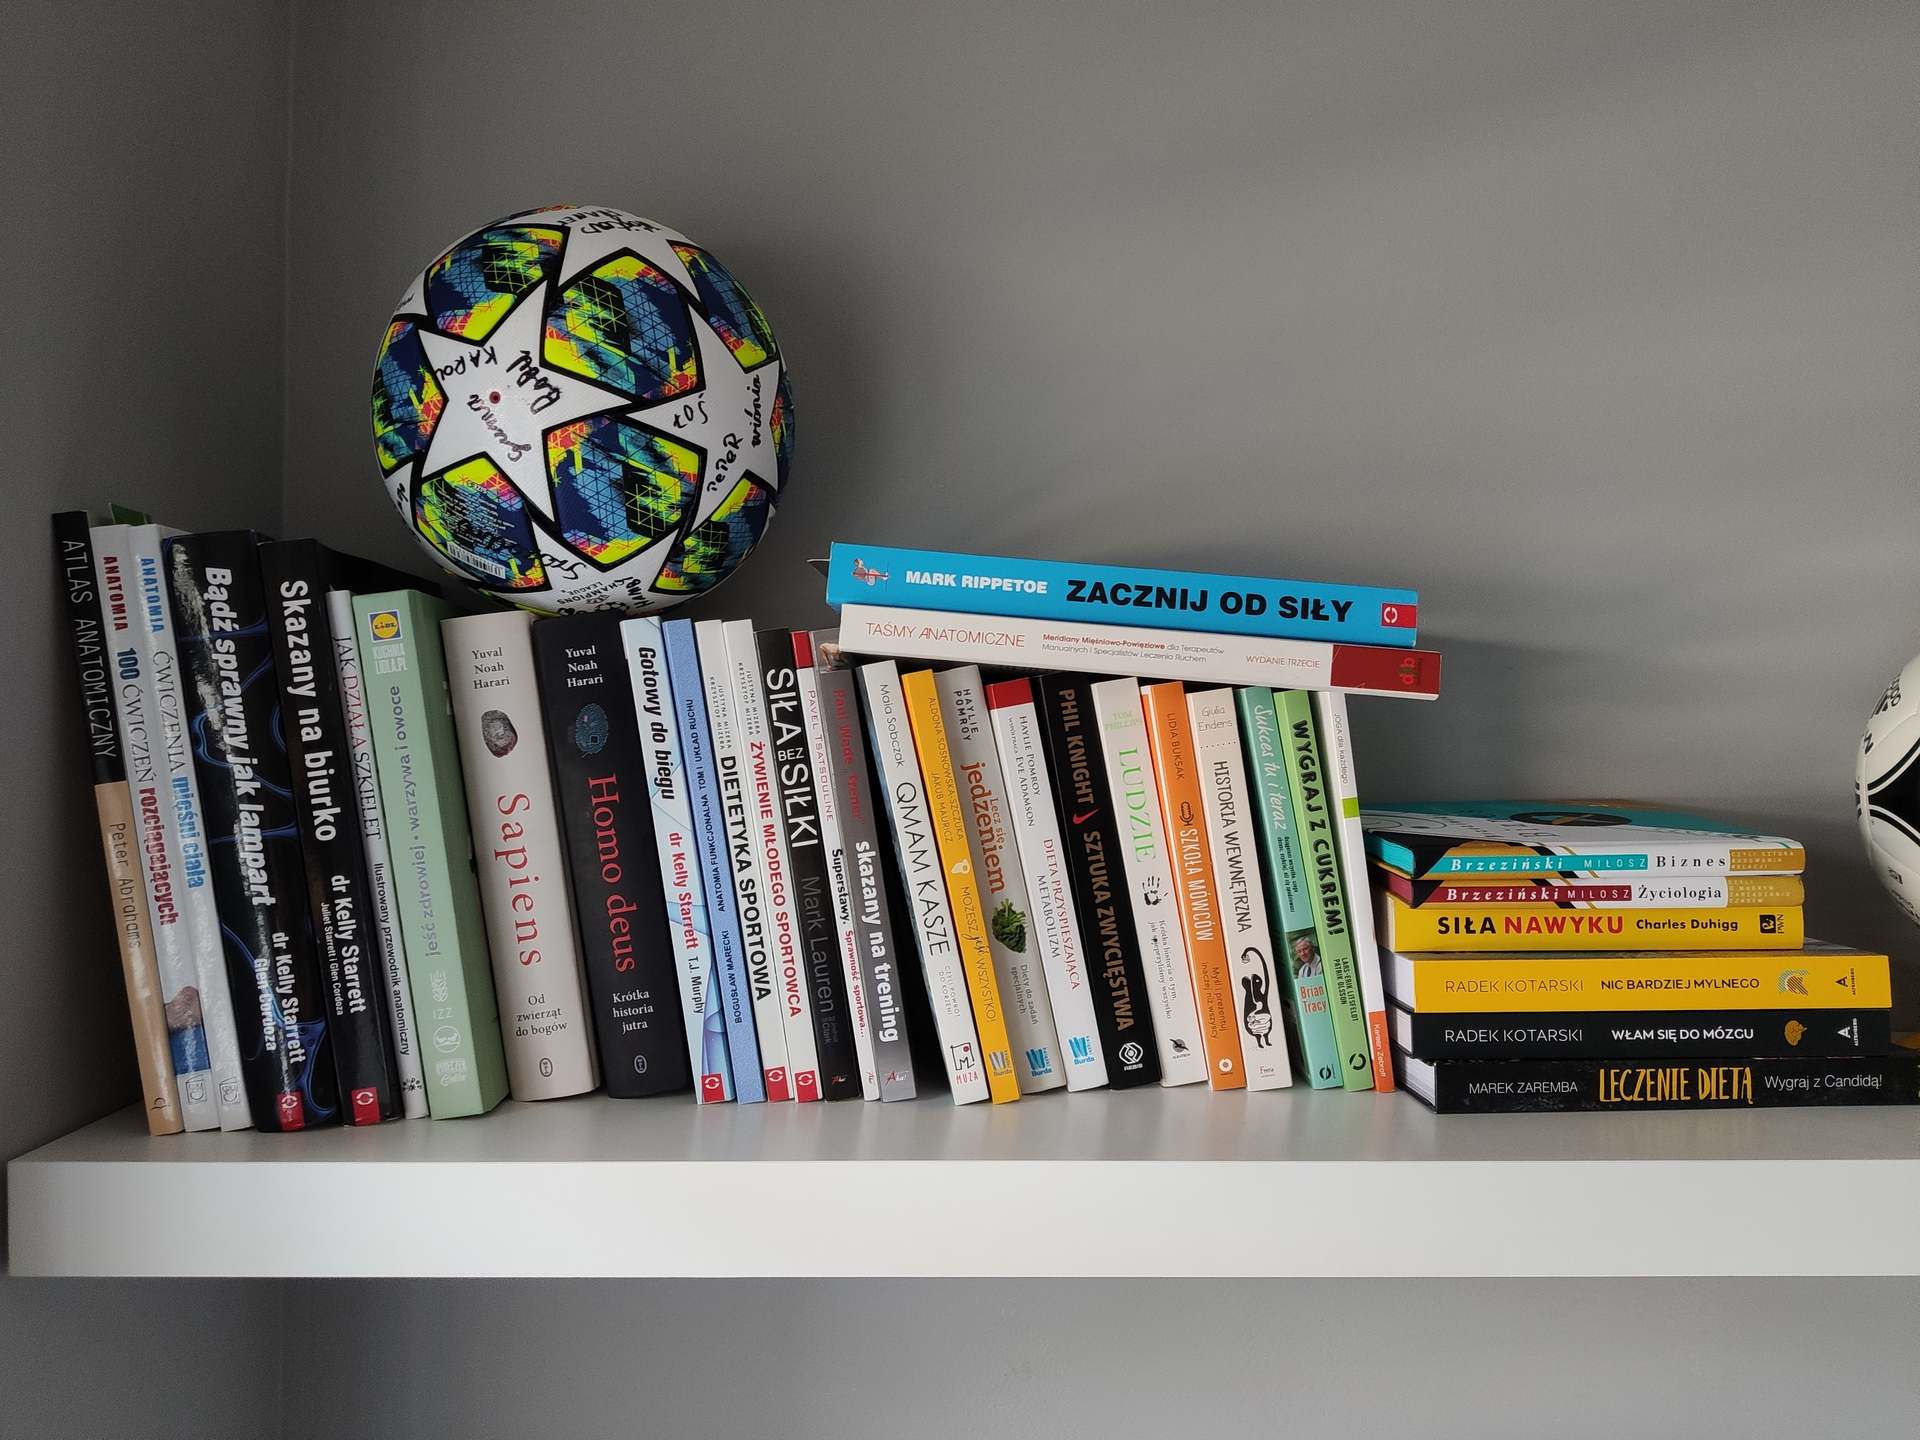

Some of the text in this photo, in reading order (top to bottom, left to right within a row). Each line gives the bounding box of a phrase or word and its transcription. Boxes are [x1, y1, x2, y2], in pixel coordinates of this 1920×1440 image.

[905, 571, 1353, 623] MARK RIPPETOE ZACZNIJ OD SIŁY
[63, 540, 117, 759] ATLAS ANATOMICZNY
[472, 647, 503, 660] Yuval
[565, 645, 596, 658] Yuval
[865, 621, 1025, 648] TAŚMY ANATOMICZNE
[1042, 643, 1138, 658] Manualnych Specjalistów
[1043, 634, 1079, 644] Meridiany
[473, 676, 510, 690] Harari
[474, 662, 505, 675] Noah
[566, 674, 603, 688] Harari
[567, 660, 598, 673] Noah
[1246, 655, 1321, 669] WYDANIE TRZECIE
[140, 558, 200, 840] ANATOMIA ĆWICZENIA mięśni
[280, 580, 341, 842] Skazany na biurko
[390, 686, 406, 740] owoce
[639, 647, 674, 800] Gotowy do biegu
[880, 683, 905, 768] Maja Sobczak
[928, 697, 941, 735] ALDONA
[954, 690, 971, 742] POMROY
[962, 688, 979, 734] HAYLIE
[1334, 713, 1344, 736] JOGA
[103, 556, 179, 926] ANATOMIA 100 ĆWICZEŃ rozciągających
[203, 567, 276, 906] Bądź sprawny jak lampart
[335, 637, 382, 840] JAK DZIAŁA SZKIELET
[767, 668, 819, 848] SIŁA BEZ SIŁKI
[1059, 688, 1095, 805] PHIL KNIGHT
[1167, 712, 1184, 780] LIDIA BUKSAK
[1254, 704, 1274, 758] Sukces
[400, 753, 420, 832] warzywa
[1264, 761, 1280, 777] tu
[930, 771, 952, 842] JAKUB MAURICZ
[960, 760, 1006, 895] jedzeniem
[1017, 775, 1034, 827] ADAMSON
[1119, 747, 1156, 863] LUDZIE
[1269, 790, 1288, 830] teraz
[1214, 760, 1252, 934] HISTORIA WEWNĘTRZNA
[1291, 720, 1345, 937] WYGRAJ Z CUKREM!
[109, 823, 141, 950] Peter Abrahams
[409, 845, 434, 918] zdrowiej
[494, 793, 542, 967] Sapiens
[588, 773, 638, 973] Homo deus
[686, 699, 742, 1024] BOGUSŁAW MARECKI ANATOMIA FUNKCJONALNA UKŁAD RUCHU
[720, 755, 771, 1001] DIETETYKA SPORTOWA
[750, 742, 801, 1017] ŻYWIENIE MŁODEGO SPORTOWCA
[855, 840, 880, 926] skazany
[896, 782, 931, 873] QMAM
[916, 879, 951, 956] KASZE
[1083, 831, 1110, 904] SZTUKA
[1180, 829, 1215, 942] SZKOŁA MÓWCÓW
[1451, 859, 1563, 872] Brzeziński
[1656, 855, 1726, 868] Biznes
[802, 876, 825, 928] Mark
[831, 849, 860, 982] Superstawy. Sprawność
[962, 886, 979, 933] MOŻESZ
[1037, 875, 1061, 959] METABOLIZM
[1043, 839, 1080, 990] DIETA PRZYSPIESZAJĄCA
[1446, 885, 1561, 901] Brzeziński
[1638, 883, 1723, 902] Życiologia
[331, 875, 366, 1013] dr Kelly Starrett
[421, 922, 441, 957] jeść
[667, 832, 704, 1014] dr Kelly Starrett T.J. Murphy
[869, 932, 886, 958] na
[1437, 916, 1739, 936] SIŁA NAWYKU Charles Duhigg
[374, 863, 410, 1056] Ilustrowany przewodnik anatomiczny
[809, 936, 834, 1013] Lauren
[1096, 905, 1136, 1031] ZWYCIĘSTWA
[1333, 959, 1342, 983] PATRIK
[1342, 957, 1354, 986] LARS-ERIK
[1444, 977, 1760, 993] RADEK KOTARSKI NIC BARDZIEJ MYLNEGO
[272, 932, 306, 1064] dr Kelly Starrett
[517, 1007, 563, 1022] zwierząt
[527, 994, 545, 1006] Od
[612, 990, 650, 1003] Krótka
[612, 1003, 654, 1018] historia
[873, 963, 899, 1043] trening
[1020, 964, 1037, 1024] Diety zadań
[1300, 985, 1324, 999] Brian
[1303, 999, 1328, 1014] Tracy
[515, 1021, 567, 1037] do bogów
[621, 1018, 648, 1034] jutra
[1444, 1024, 1755, 1043] RADEK KOTARSKI WŁAM SIĘ DO MÓZGU
[956, 1071, 979, 1085] MUZA
[1468, 1066, 1883, 1104] MAREK ZAREMBA LECZENIE DIETĄ Wygraj z Candidą!
